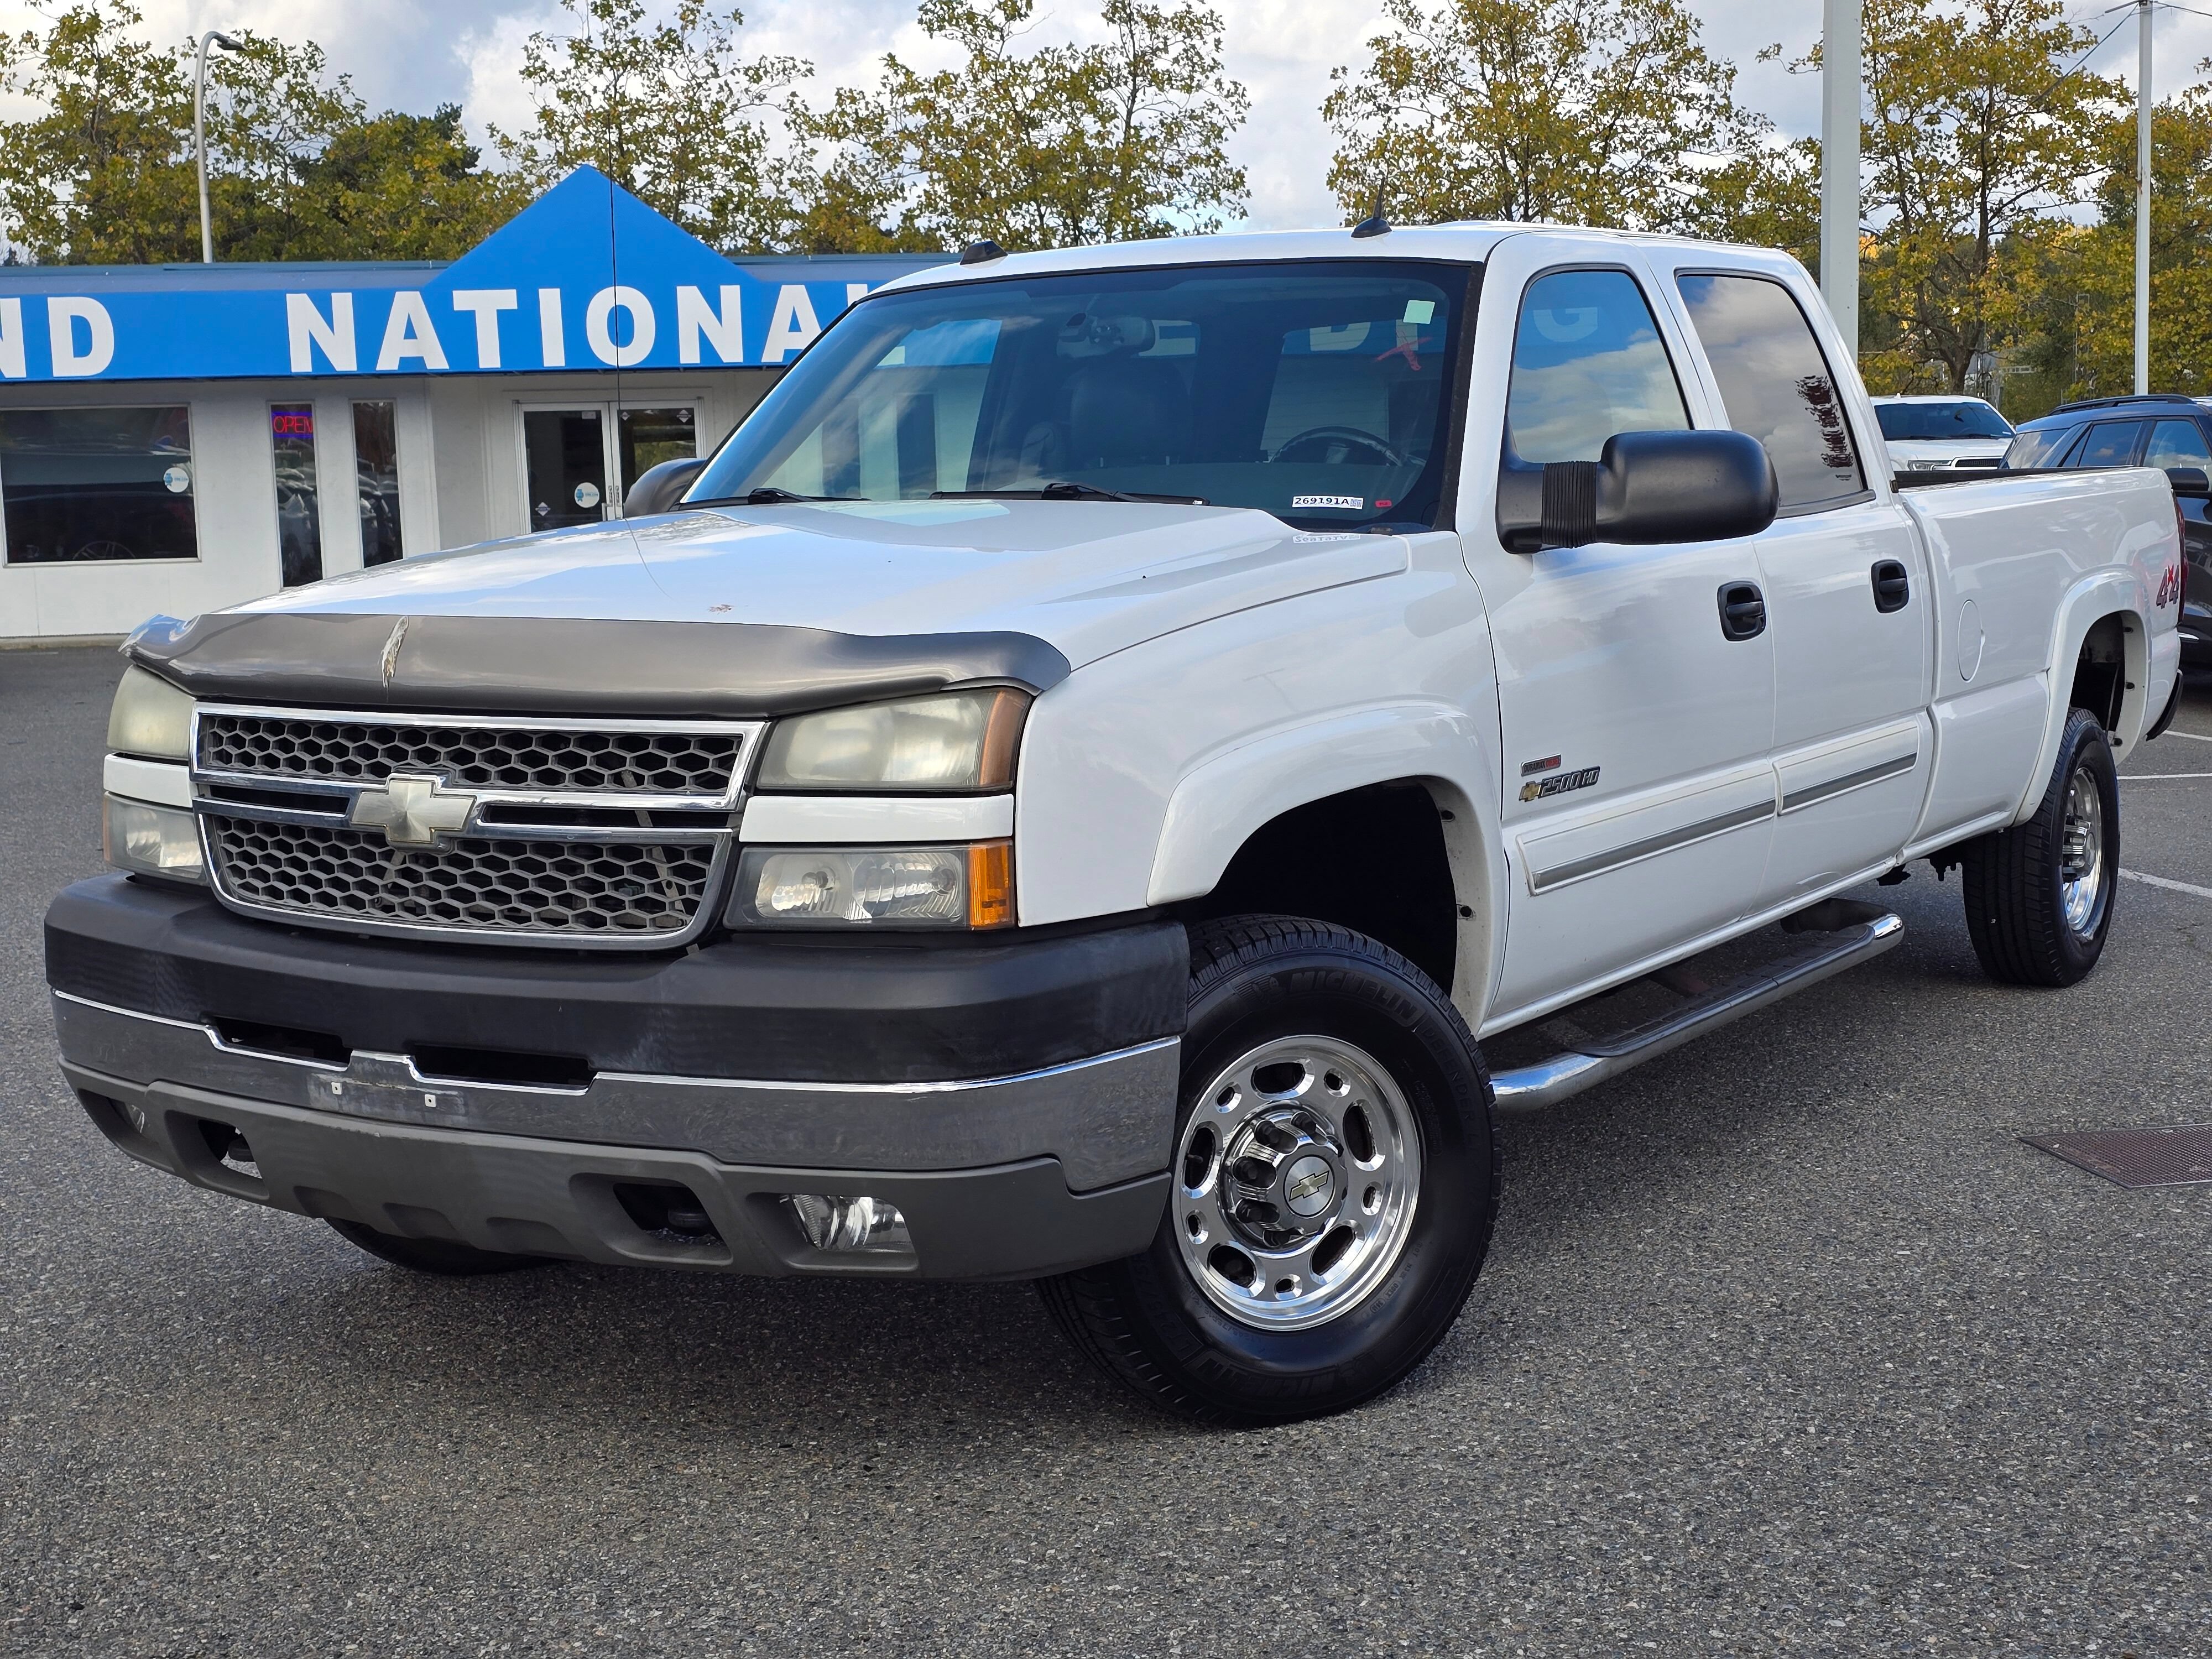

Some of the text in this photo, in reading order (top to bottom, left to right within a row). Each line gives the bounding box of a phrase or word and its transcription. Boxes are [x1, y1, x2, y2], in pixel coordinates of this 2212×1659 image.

[274, 415, 313, 434] OPEN
[1295, 497, 1350, 505] 269191A
[1524, 761, 1546, 773] DURAMAX
[1290, 971, 1416, 1021] MICHELIN
